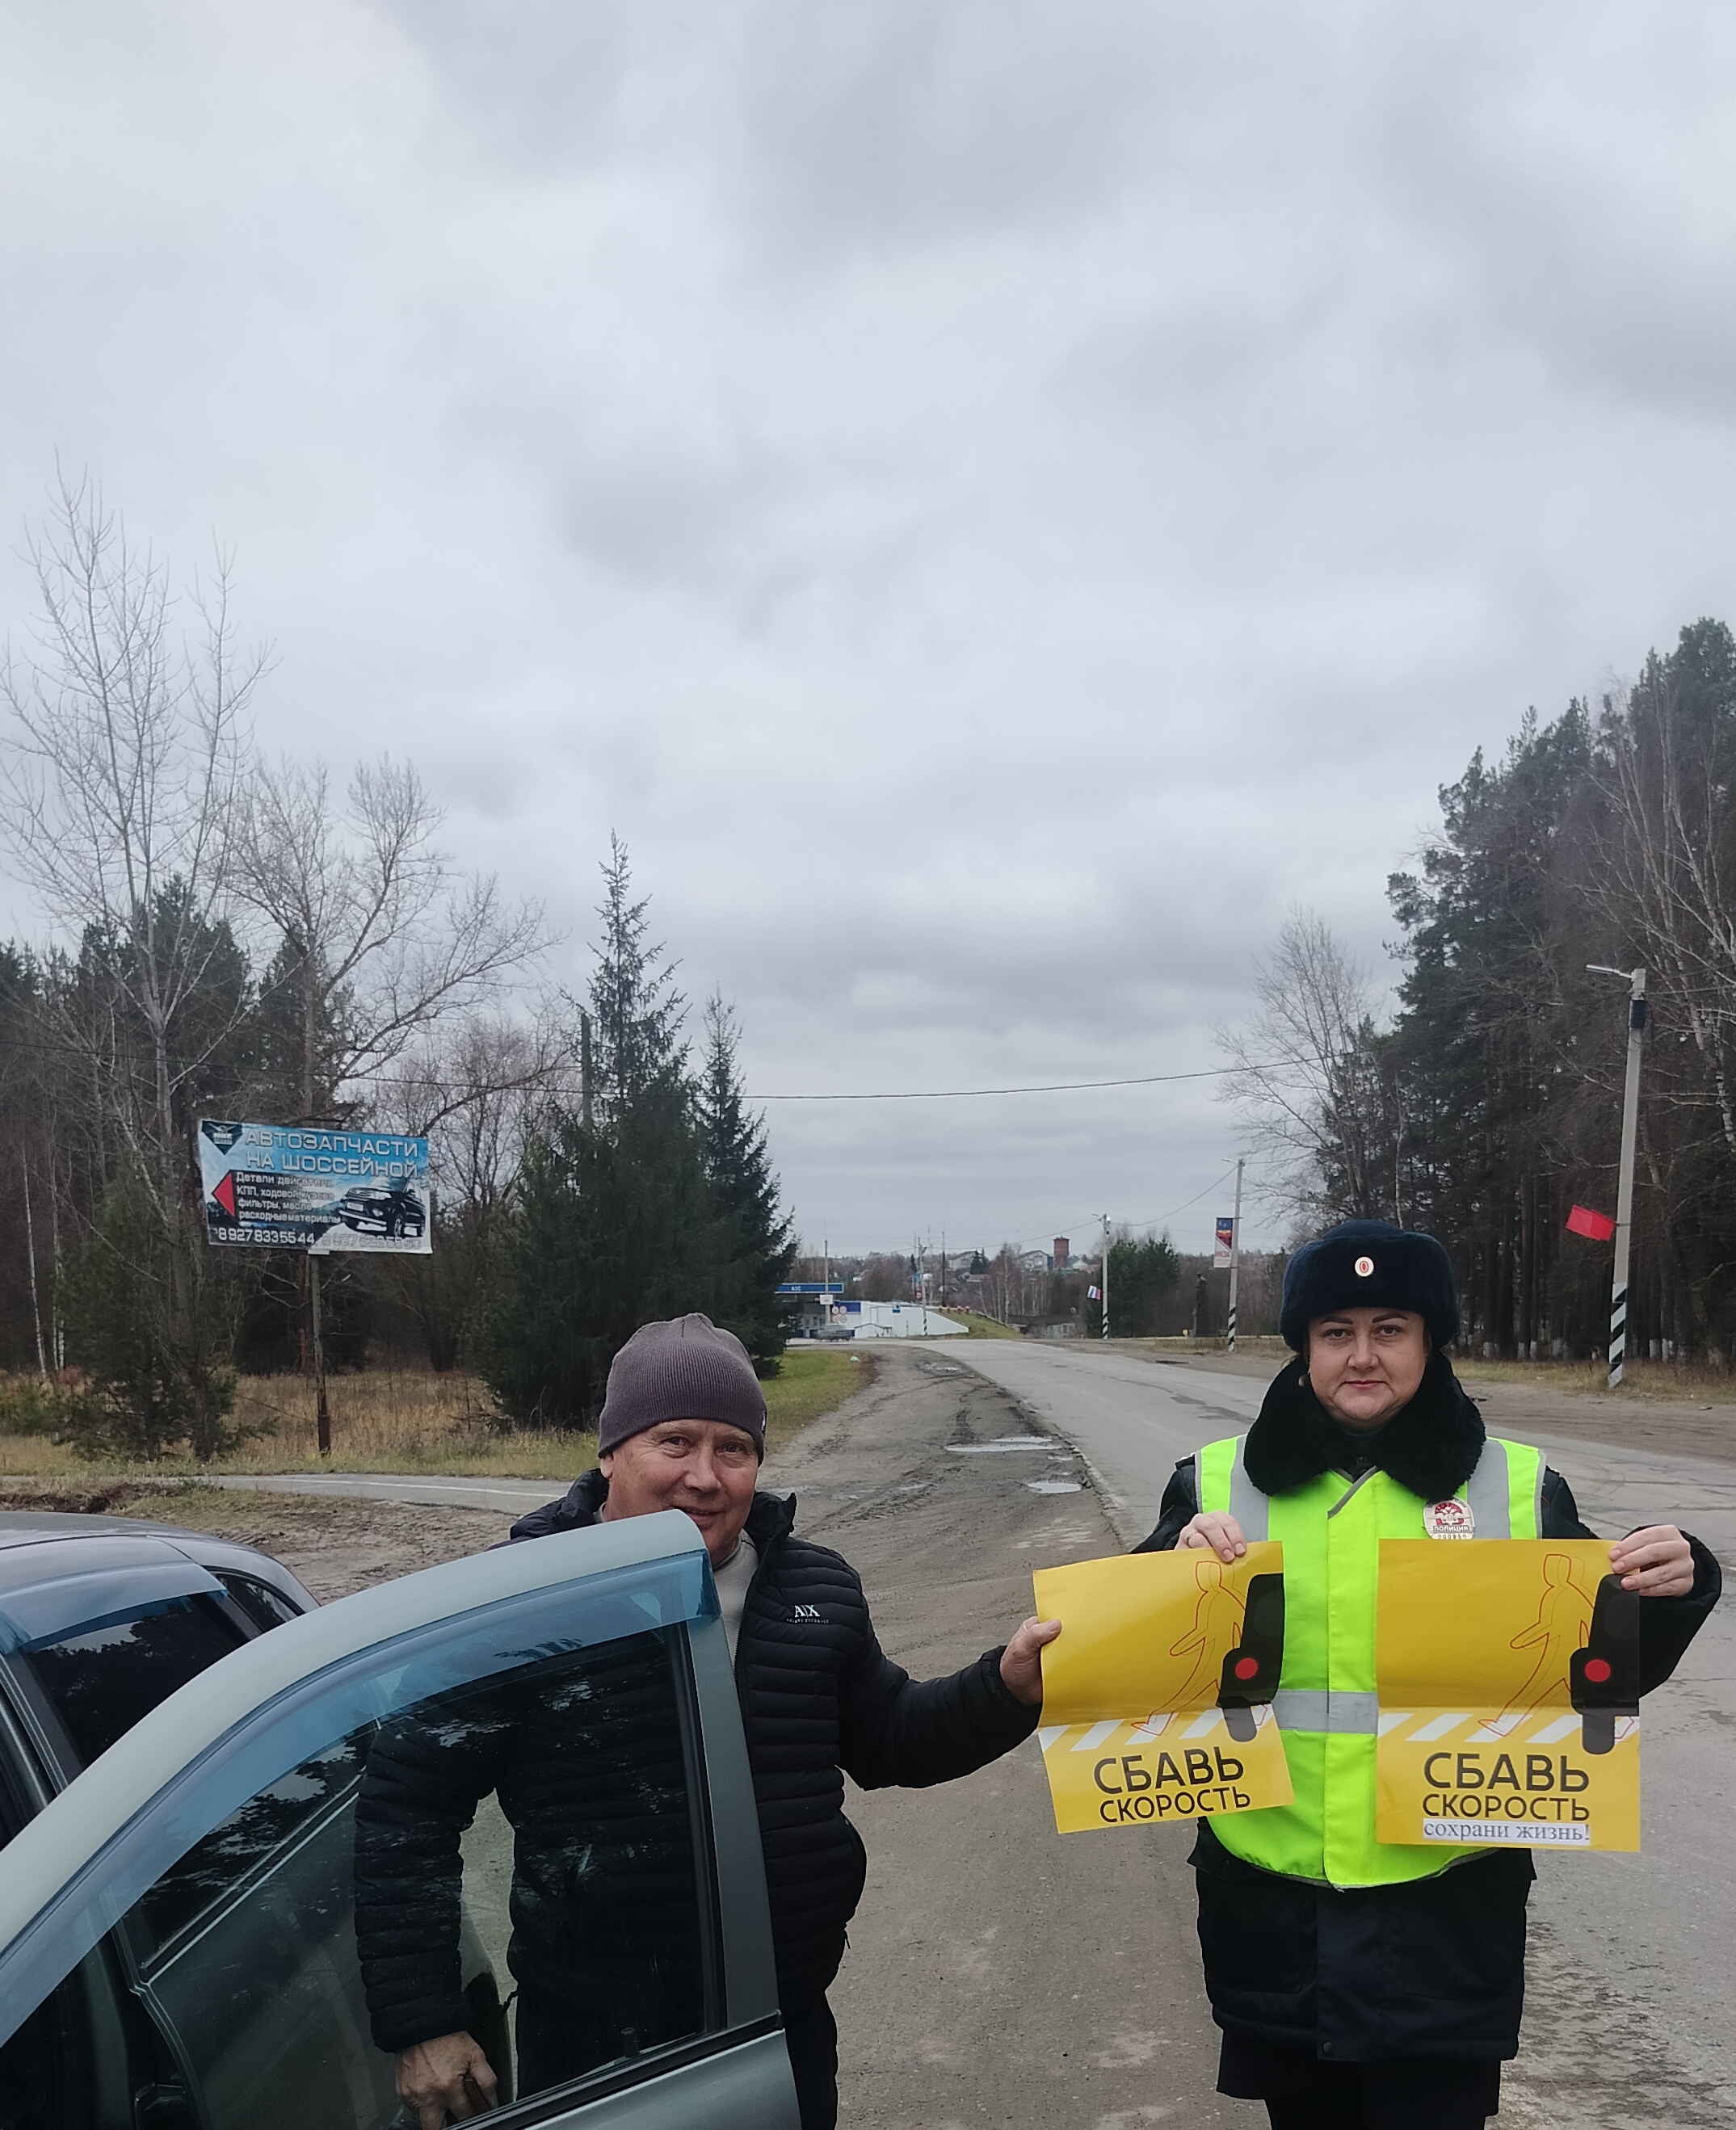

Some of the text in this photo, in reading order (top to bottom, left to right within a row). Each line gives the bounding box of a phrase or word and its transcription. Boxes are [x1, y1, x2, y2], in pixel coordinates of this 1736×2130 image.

[245, 1130, 418, 1157] АВТОЗАПЧАСТИ
[246, 1151, 418, 1179] НА ШОССЕЙНОЙ
[236, 1172, 334, 1187] Детали двигателя
[239, 1211, 341, 1224] расходные материалы
[1094, 1746, 1244, 1794] СБАВЬ
[1424, 1752, 1590, 1792] СБАВЬ
[1099, 1786, 1251, 1823] СКОРОСТЬ
[1423, 1794, 1590, 1821] СКОРОСТЬ
[1423, 1822, 1590, 1841] сохрани жизнь!
